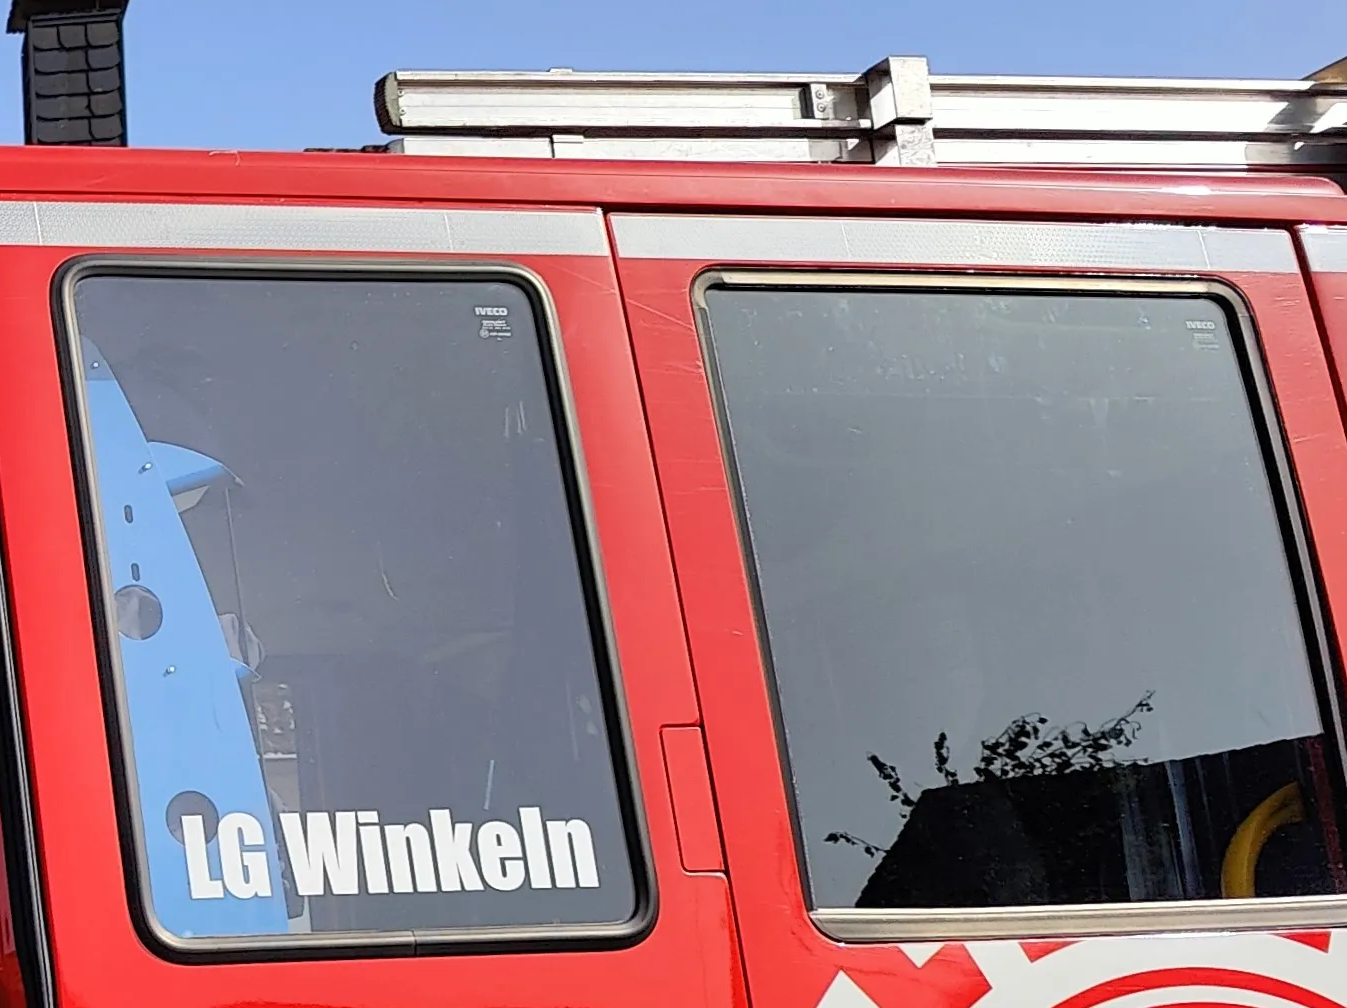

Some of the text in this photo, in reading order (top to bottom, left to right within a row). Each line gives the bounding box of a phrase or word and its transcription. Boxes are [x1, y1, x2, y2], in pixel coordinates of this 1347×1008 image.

[474, 306, 508, 316] IVECO
[1185, 320, 1216, 330] IVECO
[180, 806, 600, 899] LG Winkeln
